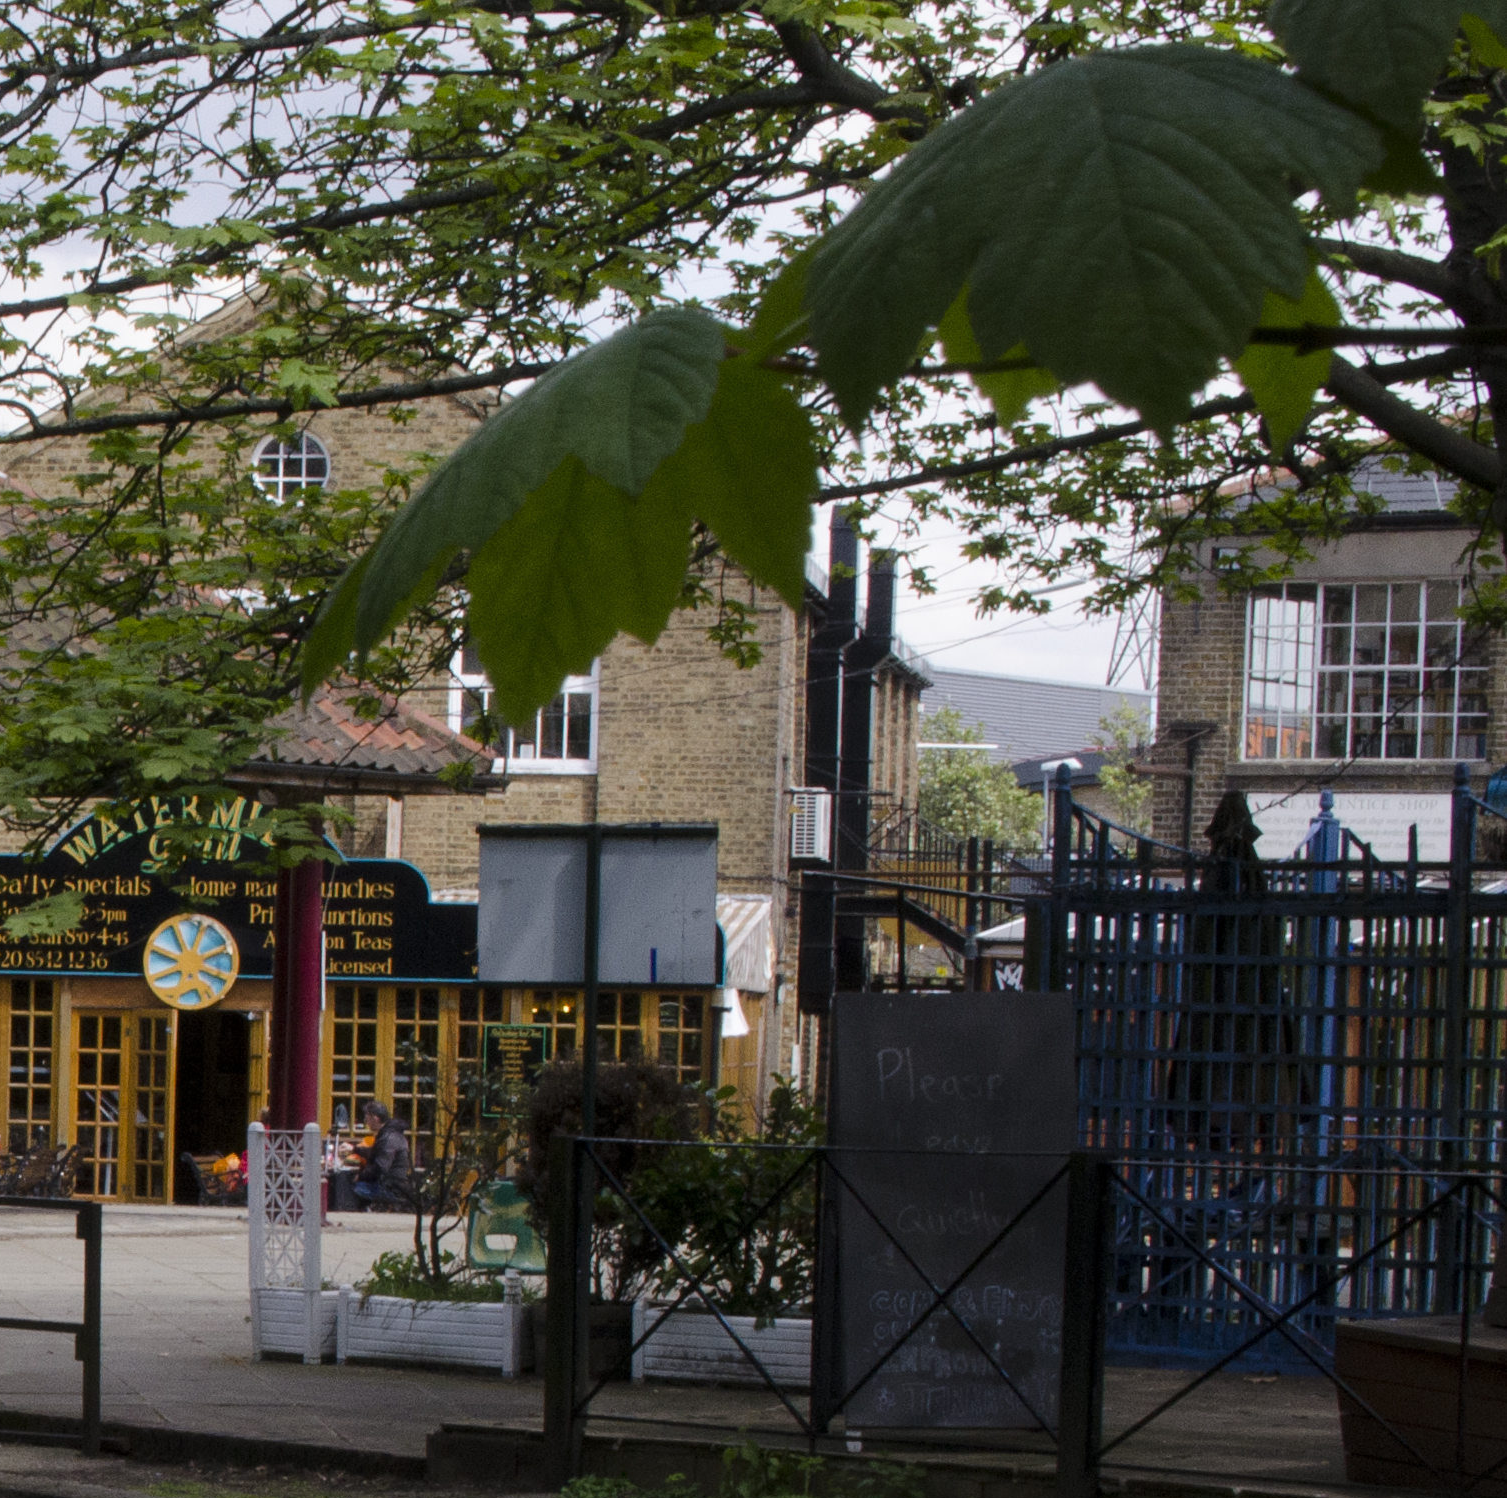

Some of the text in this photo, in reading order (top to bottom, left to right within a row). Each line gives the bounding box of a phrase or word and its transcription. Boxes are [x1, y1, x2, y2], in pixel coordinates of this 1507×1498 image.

[1397, 798, 1438, 810] SHOP
[321, 878, 395, 898] unches
[322, 908, 394, 927] unctions
[351, 931, 393, 950] Teas
[325, 957, 393, 975] icensed
